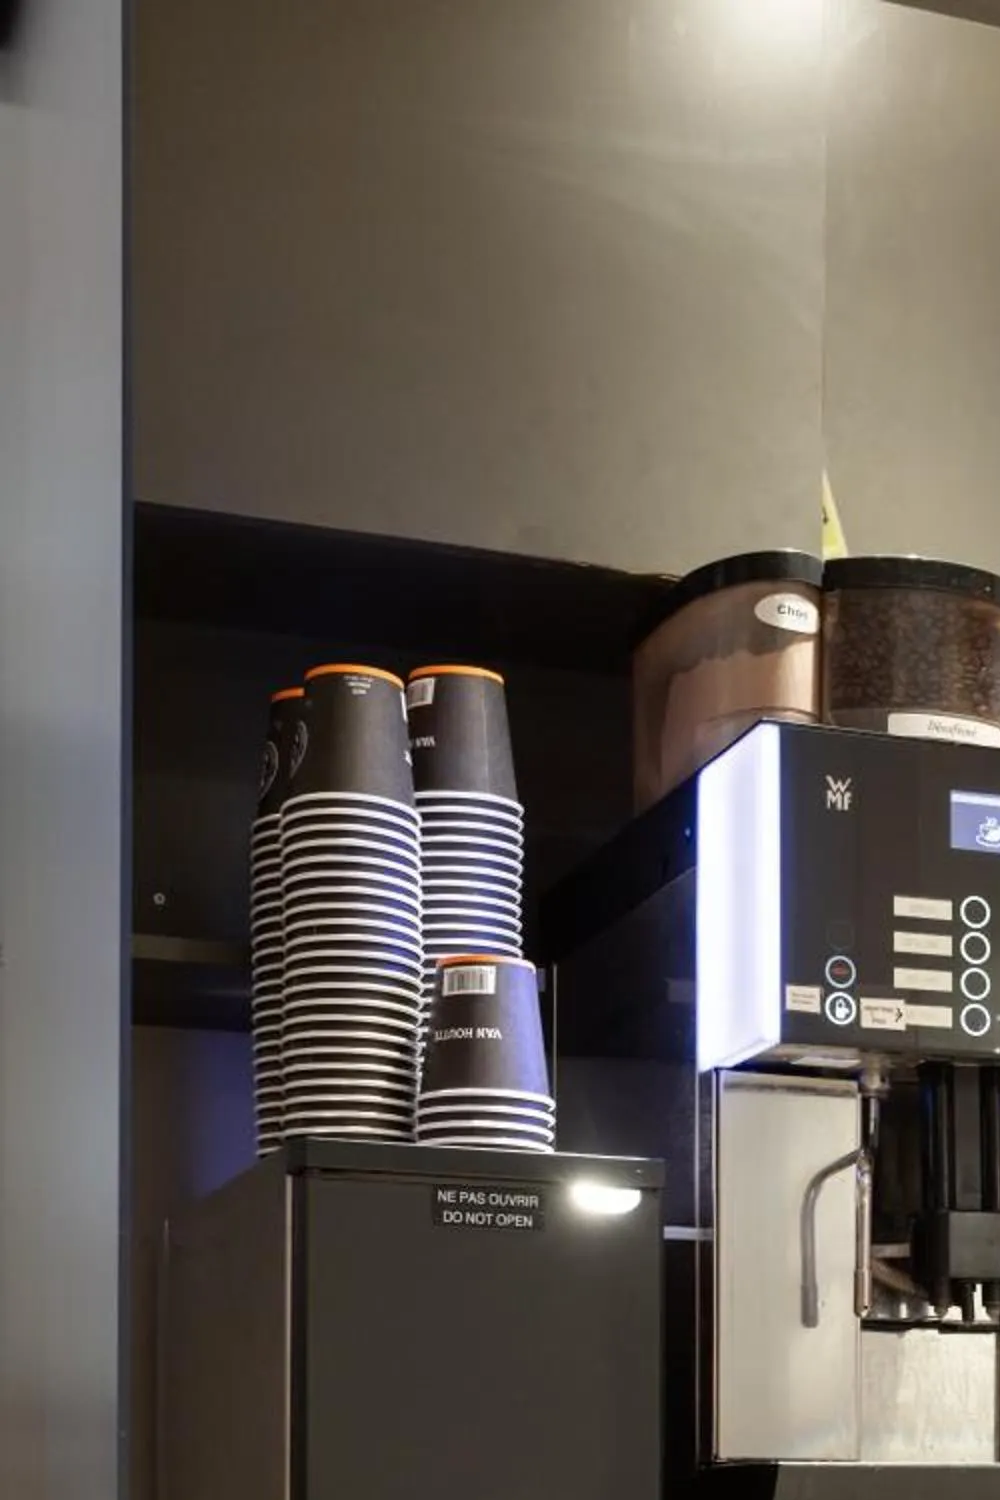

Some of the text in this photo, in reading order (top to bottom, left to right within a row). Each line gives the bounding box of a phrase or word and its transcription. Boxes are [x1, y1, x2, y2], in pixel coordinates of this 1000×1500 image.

[475, 1027, 503, 1042] VAN
[437, 1189, 539, 1208] NE PAS OUVRIR
[443, 1210, 533, 1227] DO NOT OPEN
